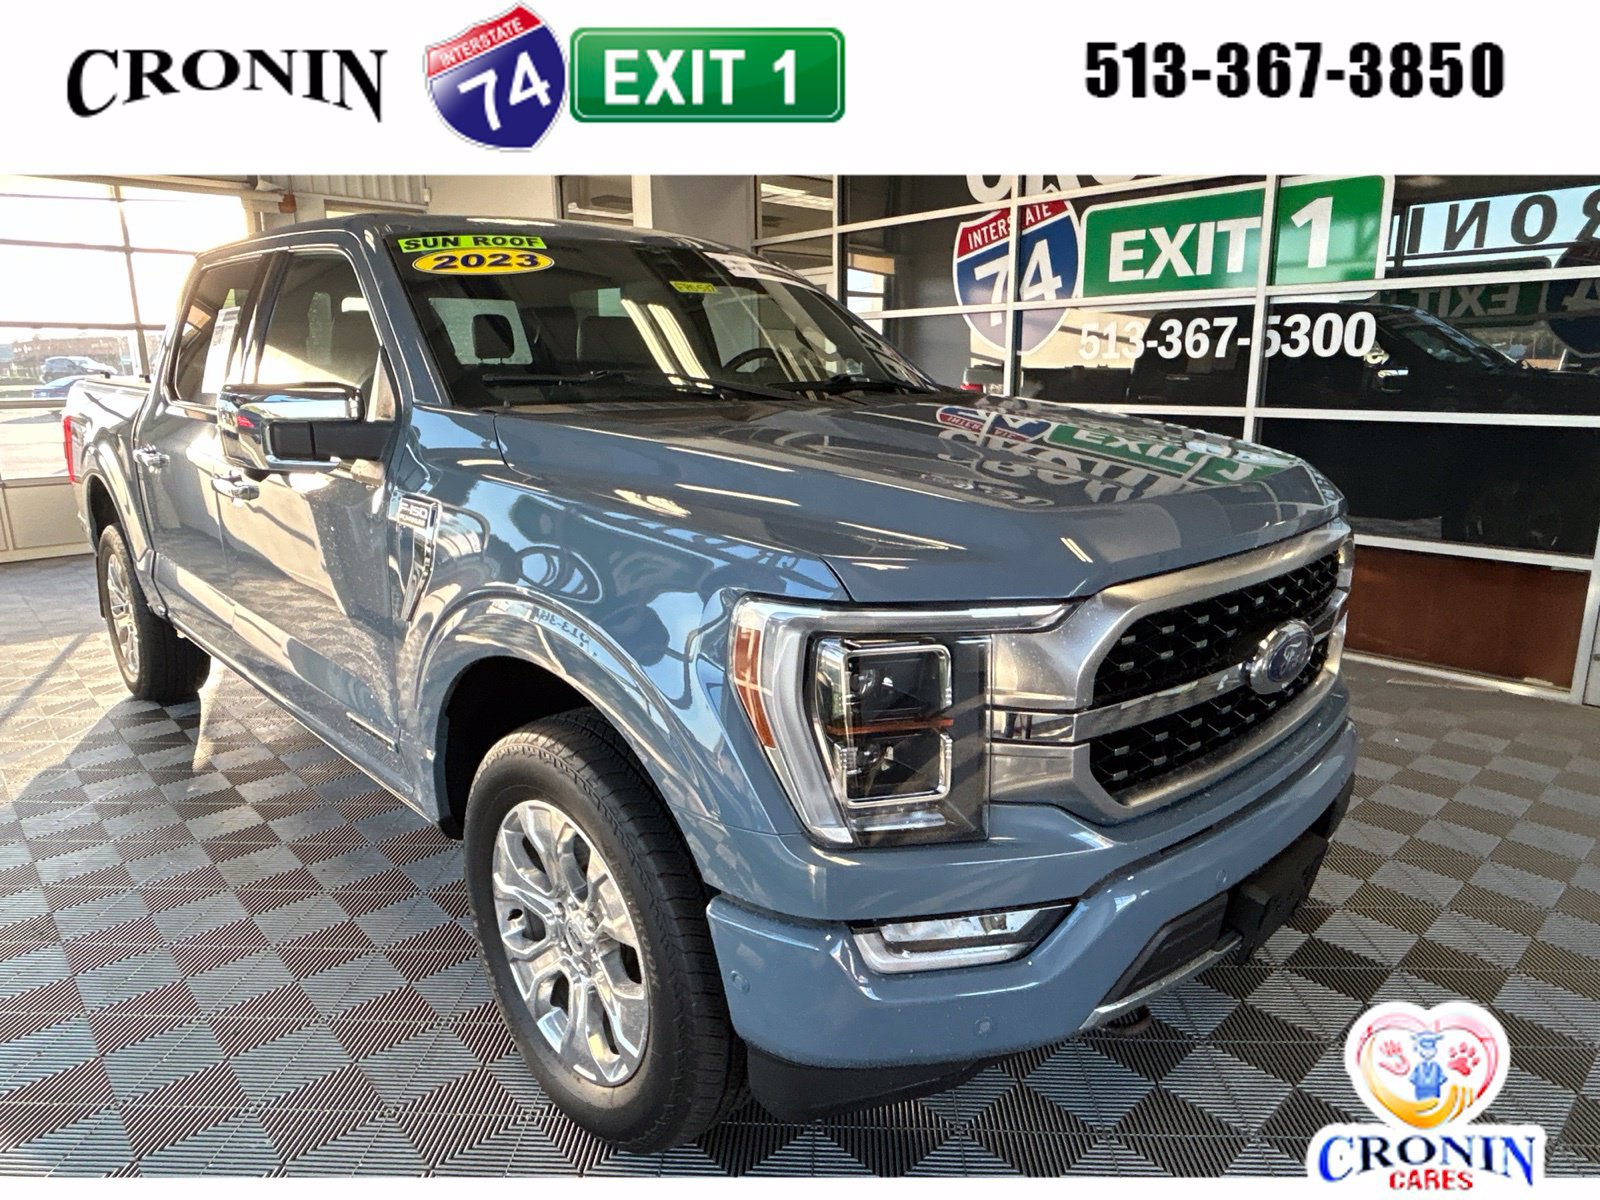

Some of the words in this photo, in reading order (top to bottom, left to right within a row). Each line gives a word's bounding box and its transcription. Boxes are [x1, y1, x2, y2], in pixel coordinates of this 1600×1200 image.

[404, 237, 459, 250] SUN
[473, 236, 541, 247] ROOF
[432, 253, 540, 270] 2023
[1108, 216, 1262, 282] EXIT
[1291, 196, 1333, 269] 1
[974, 239, 1062, 327] 74
[1079, 311, 1377, 361] 513-367-5300
